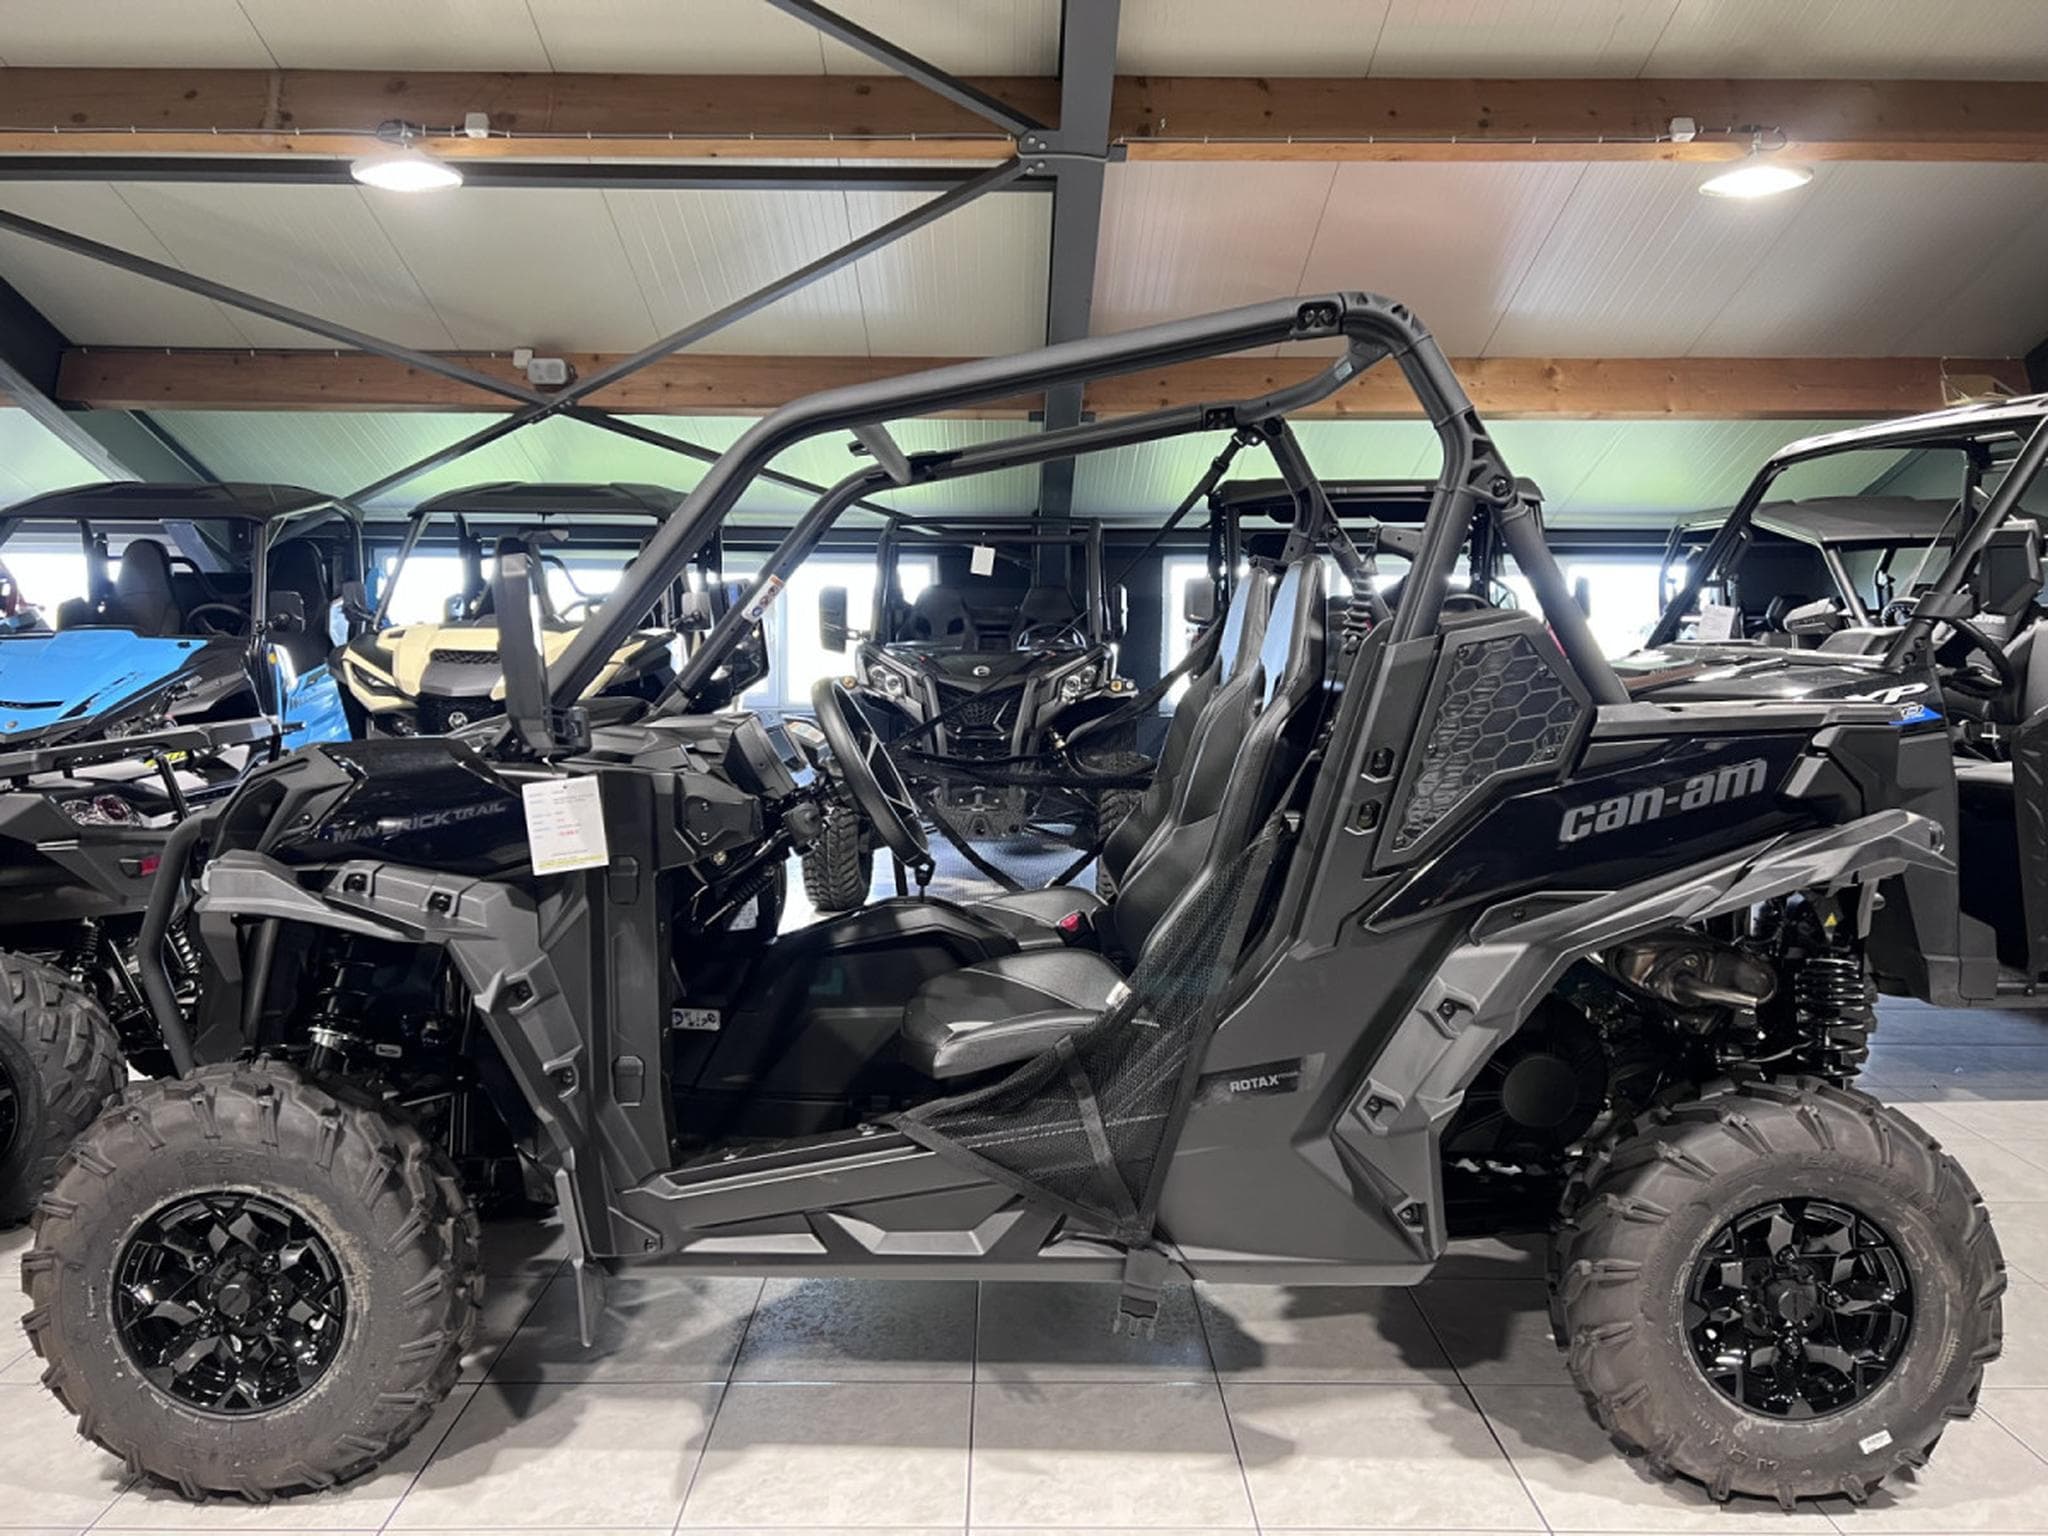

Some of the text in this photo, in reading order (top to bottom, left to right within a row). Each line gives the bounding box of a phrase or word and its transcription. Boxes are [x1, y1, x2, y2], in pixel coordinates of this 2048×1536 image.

[1558, 758, 1768, 842] can-am
[453, 802, 507, 820] TRAIL
[1230, 1074, 1280, 1092] ROTAX
